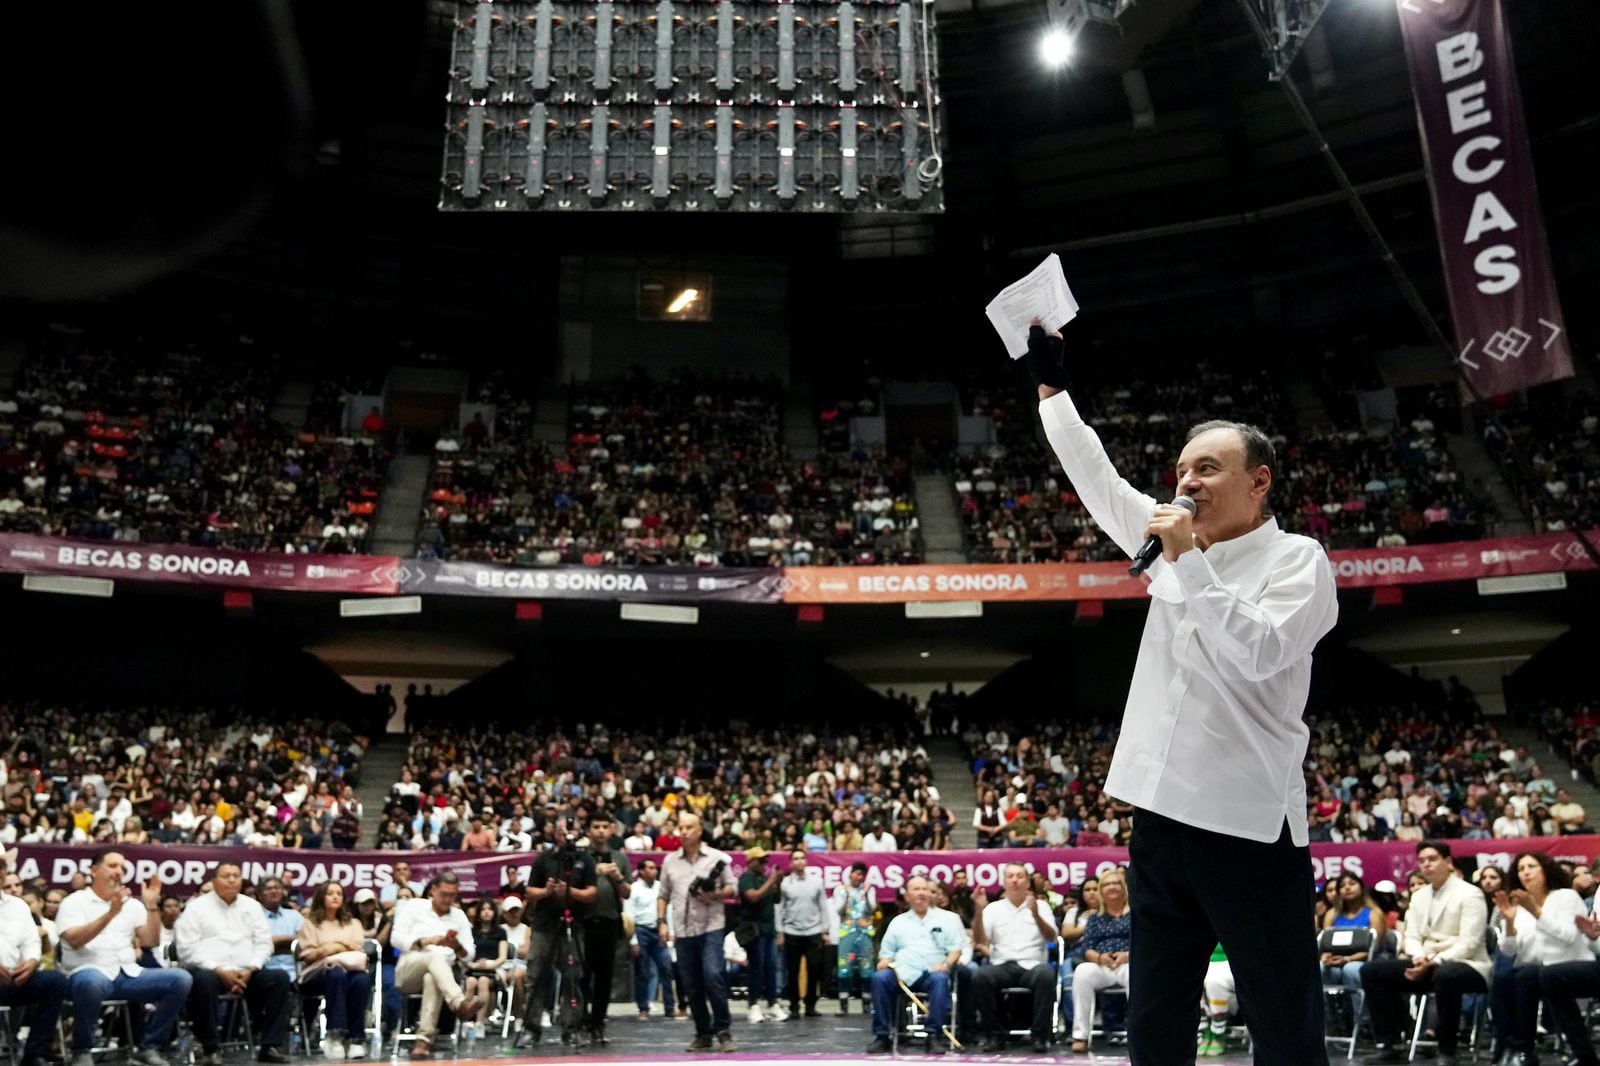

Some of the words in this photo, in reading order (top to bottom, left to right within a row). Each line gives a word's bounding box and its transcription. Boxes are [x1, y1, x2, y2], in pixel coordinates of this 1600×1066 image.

[1435, 31, 1521, 295] BECAS
[58, 546, 142, 570] BECAS
[148, 553, 251, 577] SONORA
[476, 570, 550, 589] BECAS
[555, 573, 648, 591] SONORA
[858, 575, 931, 592] BECAS
[935, 573, 1028, 592] SONORA
[1047, 861, 1088, 886] DE
